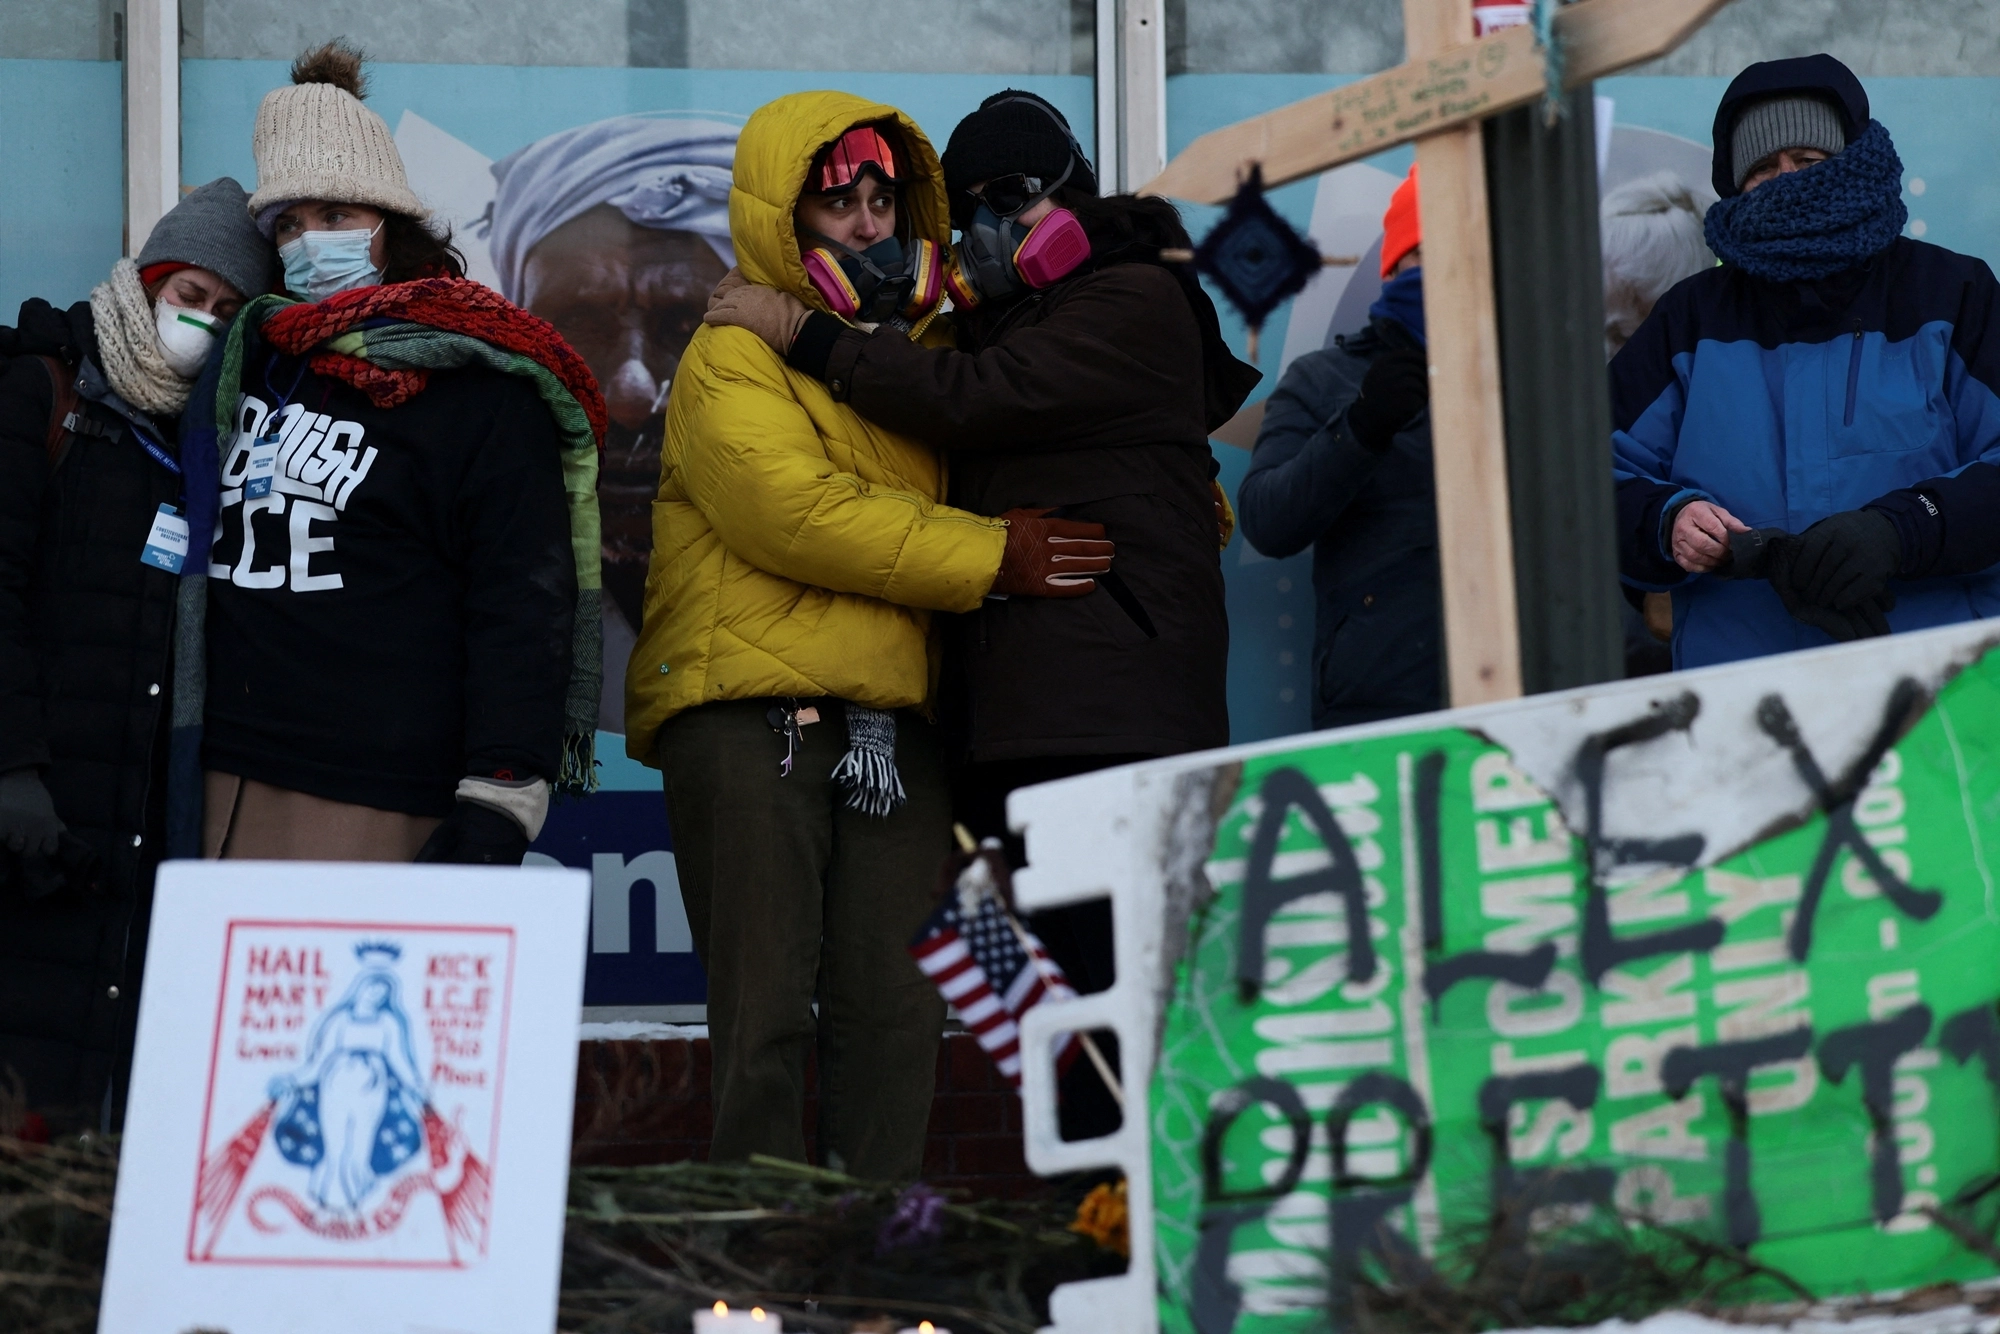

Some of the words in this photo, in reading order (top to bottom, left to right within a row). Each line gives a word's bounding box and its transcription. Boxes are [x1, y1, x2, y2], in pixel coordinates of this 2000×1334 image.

[1237, 675, 1943, 1008] ALEX
[247, 946, 331, 978] HAIL
[427, 955, 490, 980] KICK
[245, 985, 327, 1008] MARY
